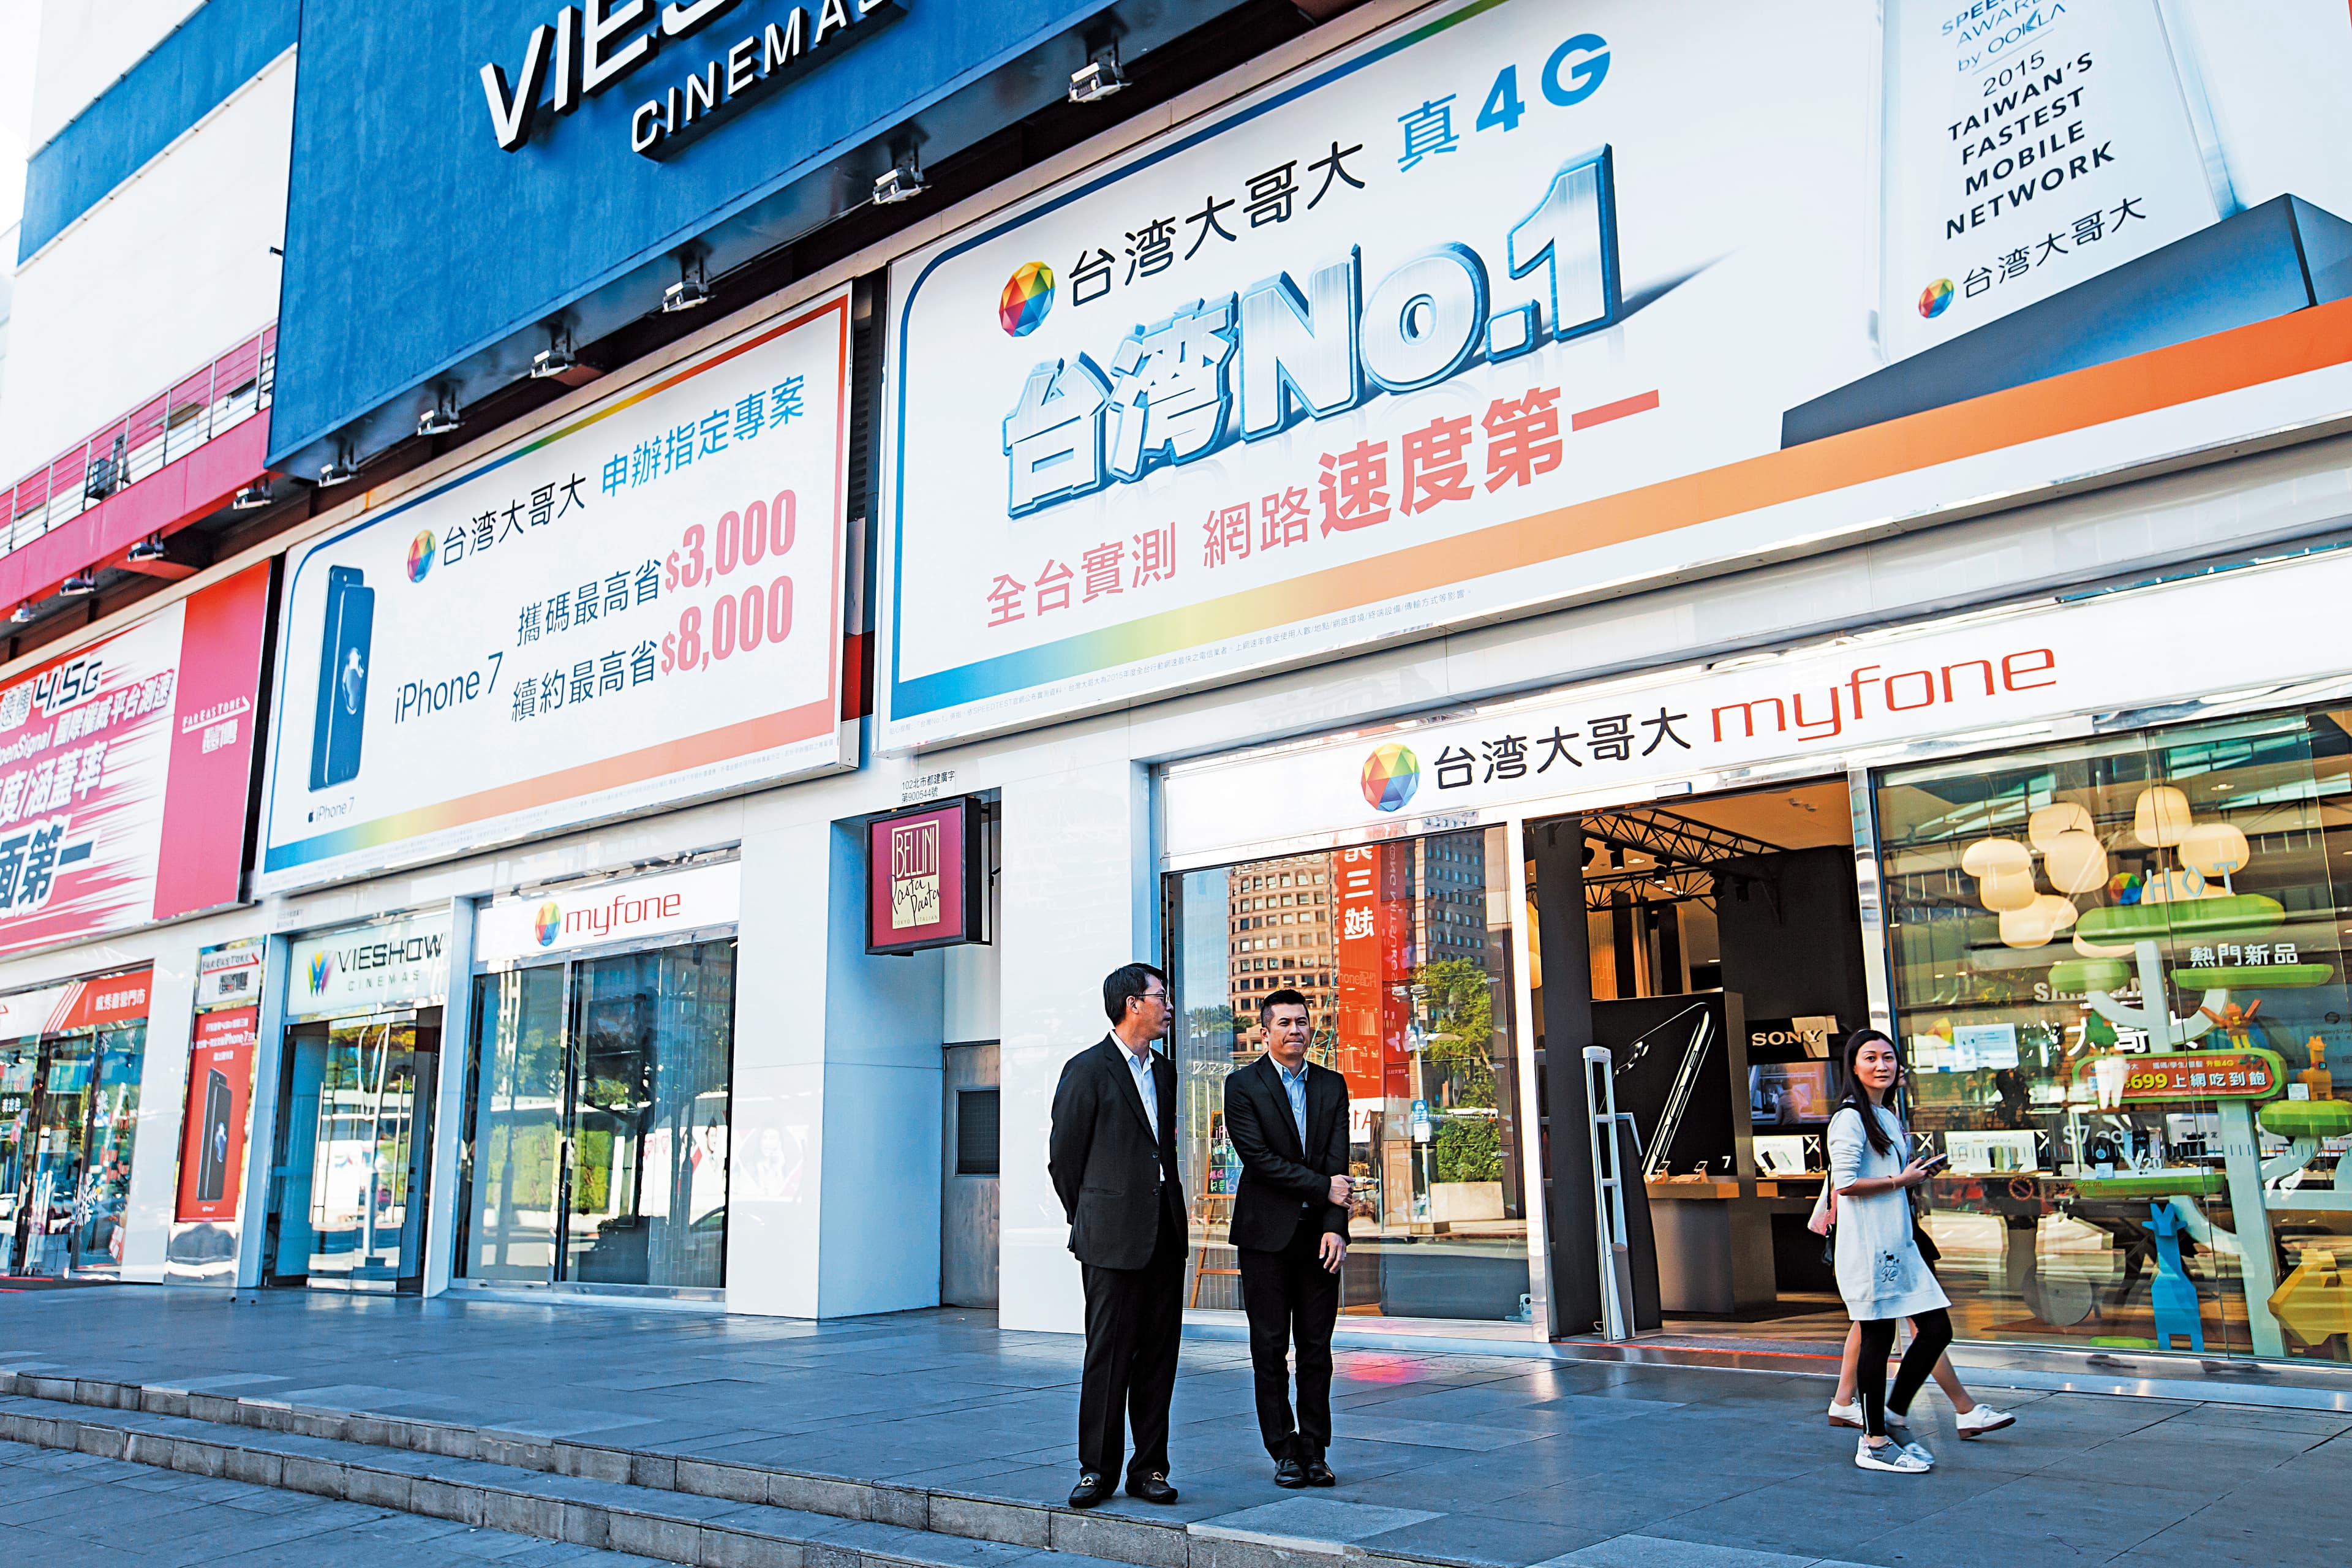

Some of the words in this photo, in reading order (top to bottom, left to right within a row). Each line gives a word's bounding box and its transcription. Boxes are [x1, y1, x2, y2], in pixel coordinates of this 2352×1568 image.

[1942, 0, 2011, 36] SPEE
[1958, 51, 1981, 72] by
[1988, 3, 2066, 53] OOKLA
[480, 0, 729, 152] VIE
[631, 0, 886, 153] CINEMA
[1948, 52, 2094, 141] TAIWAN'S
[1983, 50, 2045, 97] 2015
[1962, 86, 2086, 166] FASTEST
[1964, 121, 2086, 196] MOBILE
[1945, 140, 2116, 241] NETWORK
[601, 374, 805, 497] 申辦指定專案
[986, 522, 1177, 629] 全台實測
[1202, 387, 1660, 570] 網路速度第一
[394, 668, 481, 725] iPhone
[486, 653, 503, 696] 7
[1711, 645, 2058, 744] myfone
[0, 740, 108, 827] 度/涵蓋率
[315, 802, 347, 823] iPhone
[348, 796, 355, 813] 7
[896, 827, 935, 878] BELLINI
[2146, 861, 2238, 902] HOT
[565, 893, 681, 937] myfone
[338, 932, 445, 973] VIESHOW
[348, 970, 420, 991] CINEMAS
[2190, 943, 2299, 968] 熱門新品
[1751, 1030, 1823, 1046] SONY
[2172, 1071, 2267, 1088] 上網吃到飽
